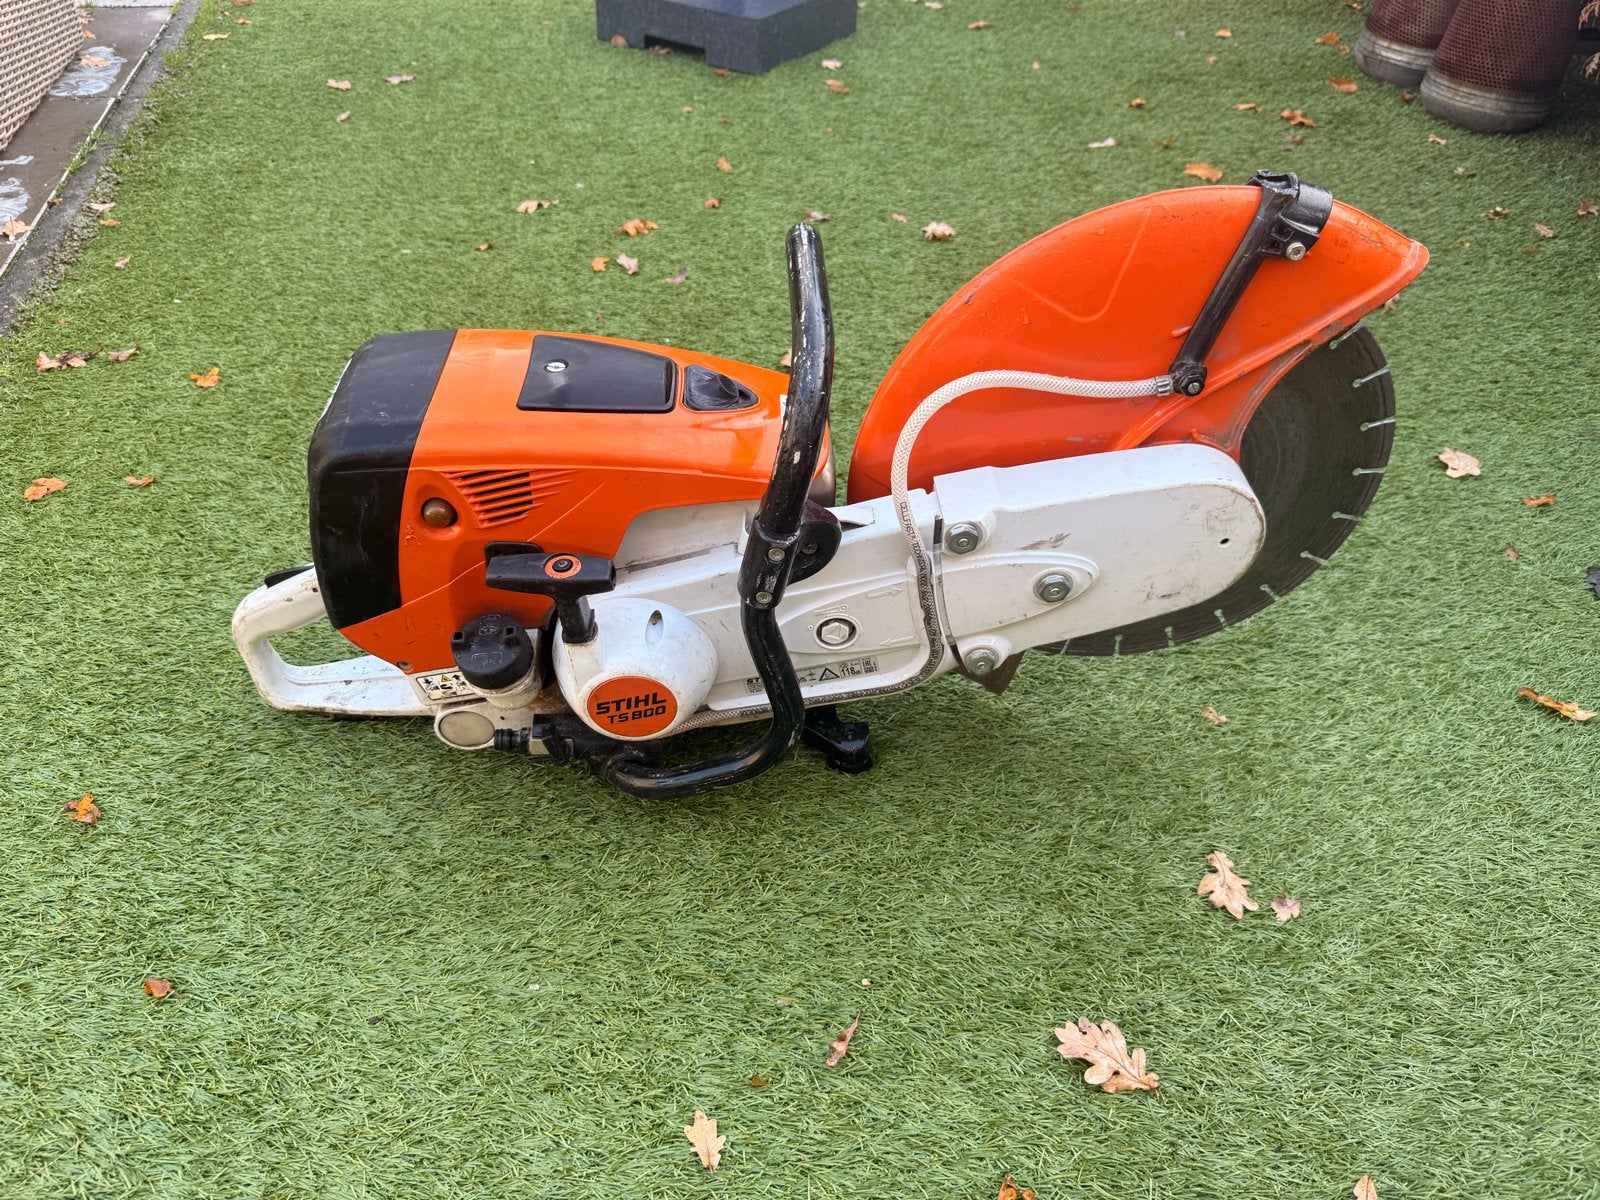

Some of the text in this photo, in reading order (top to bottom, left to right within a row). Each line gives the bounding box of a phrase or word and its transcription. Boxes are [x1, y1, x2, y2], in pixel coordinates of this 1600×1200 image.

[596, 692, 667, 715] STIHL
[607, 705, 667, 724] TS 800
